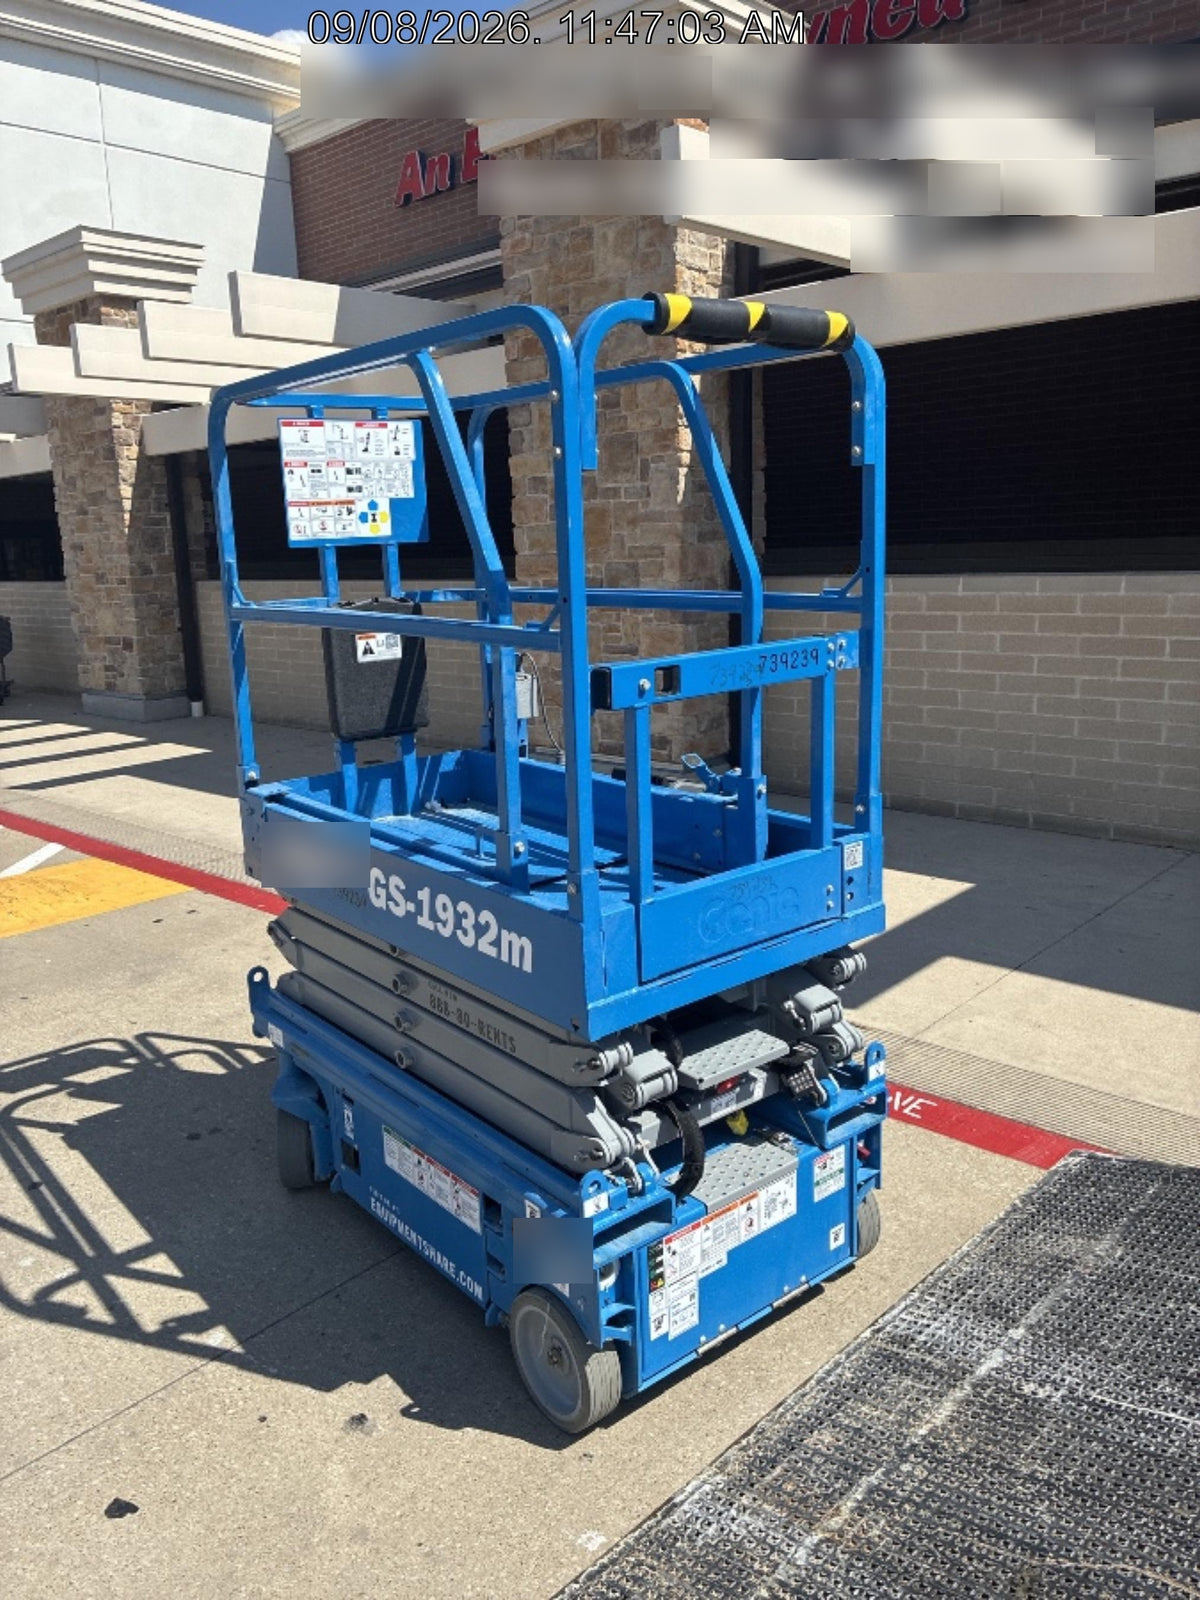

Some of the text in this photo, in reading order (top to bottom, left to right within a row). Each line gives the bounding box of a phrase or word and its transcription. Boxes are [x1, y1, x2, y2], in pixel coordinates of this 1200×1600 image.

[394, 151, 451, 207] An
[759, 648, 820, 674] 739239
[368, 866, 533, 974] GS-1932m
